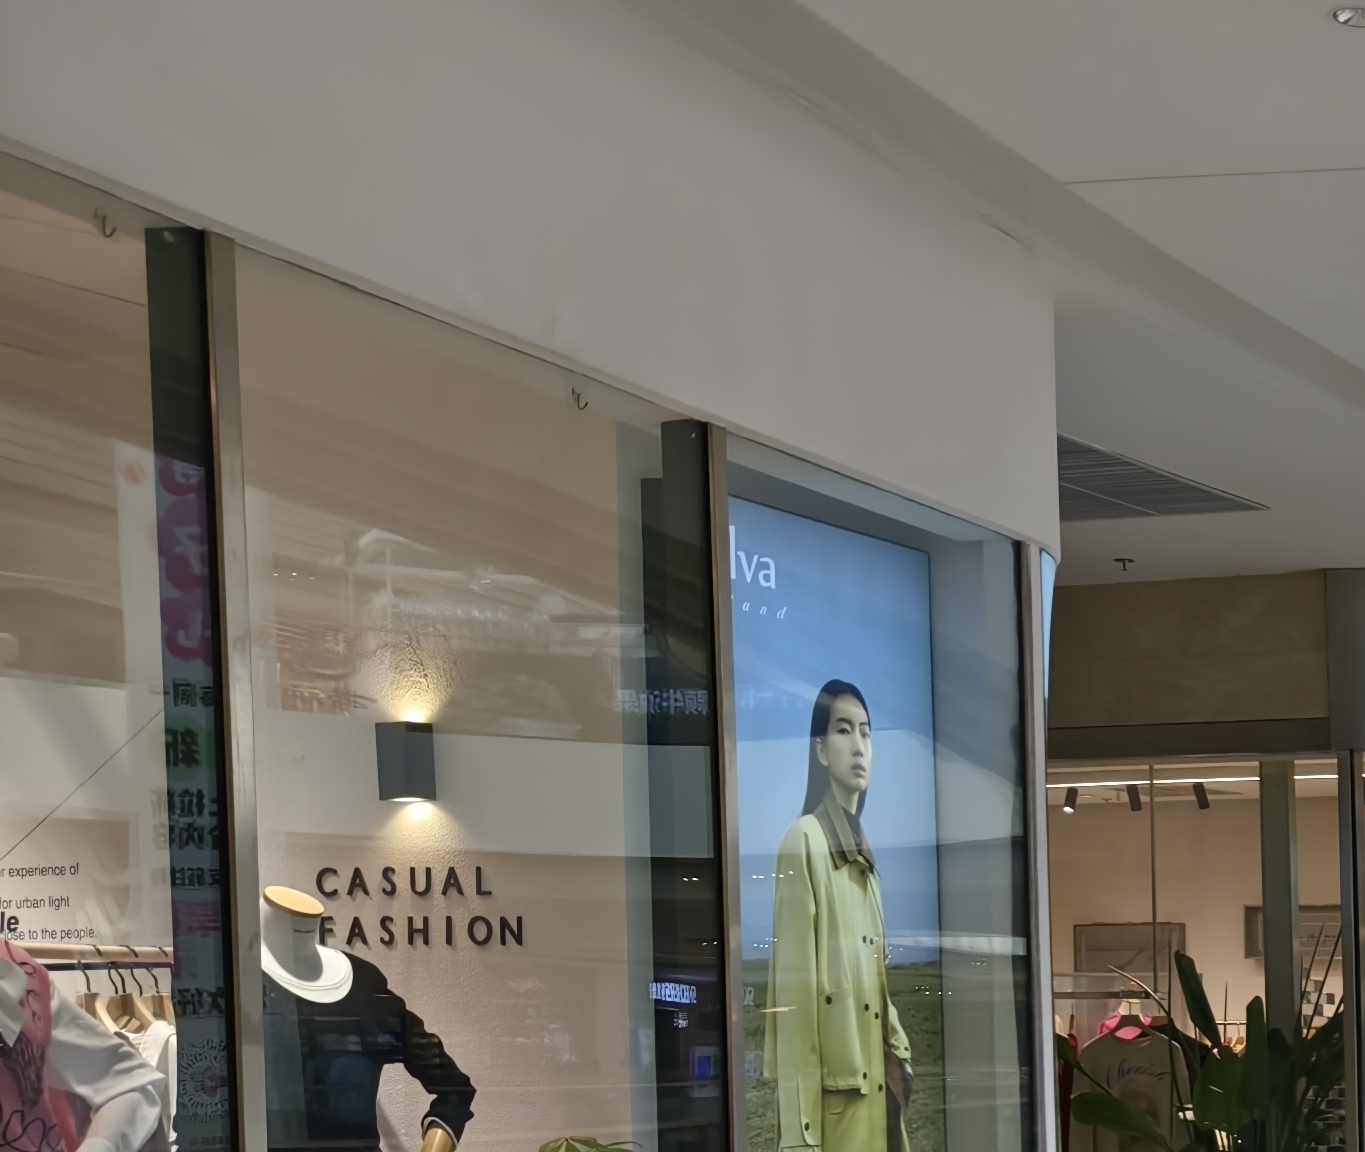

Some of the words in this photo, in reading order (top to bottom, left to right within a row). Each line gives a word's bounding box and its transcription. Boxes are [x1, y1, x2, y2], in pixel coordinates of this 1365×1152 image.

[731, 595, 787, 621] and
[8, 864, 66, 879] experience
[70, 863, 79, 875] of
[316, 866, 493, 897] CASUAL
[16, 897, 45, 909] urban
[49, 896, 70, 911] light
[28, 928, 38, 940] to
[41, 927, 57, 940] the
[319, 916, 523, 946] FASHION
